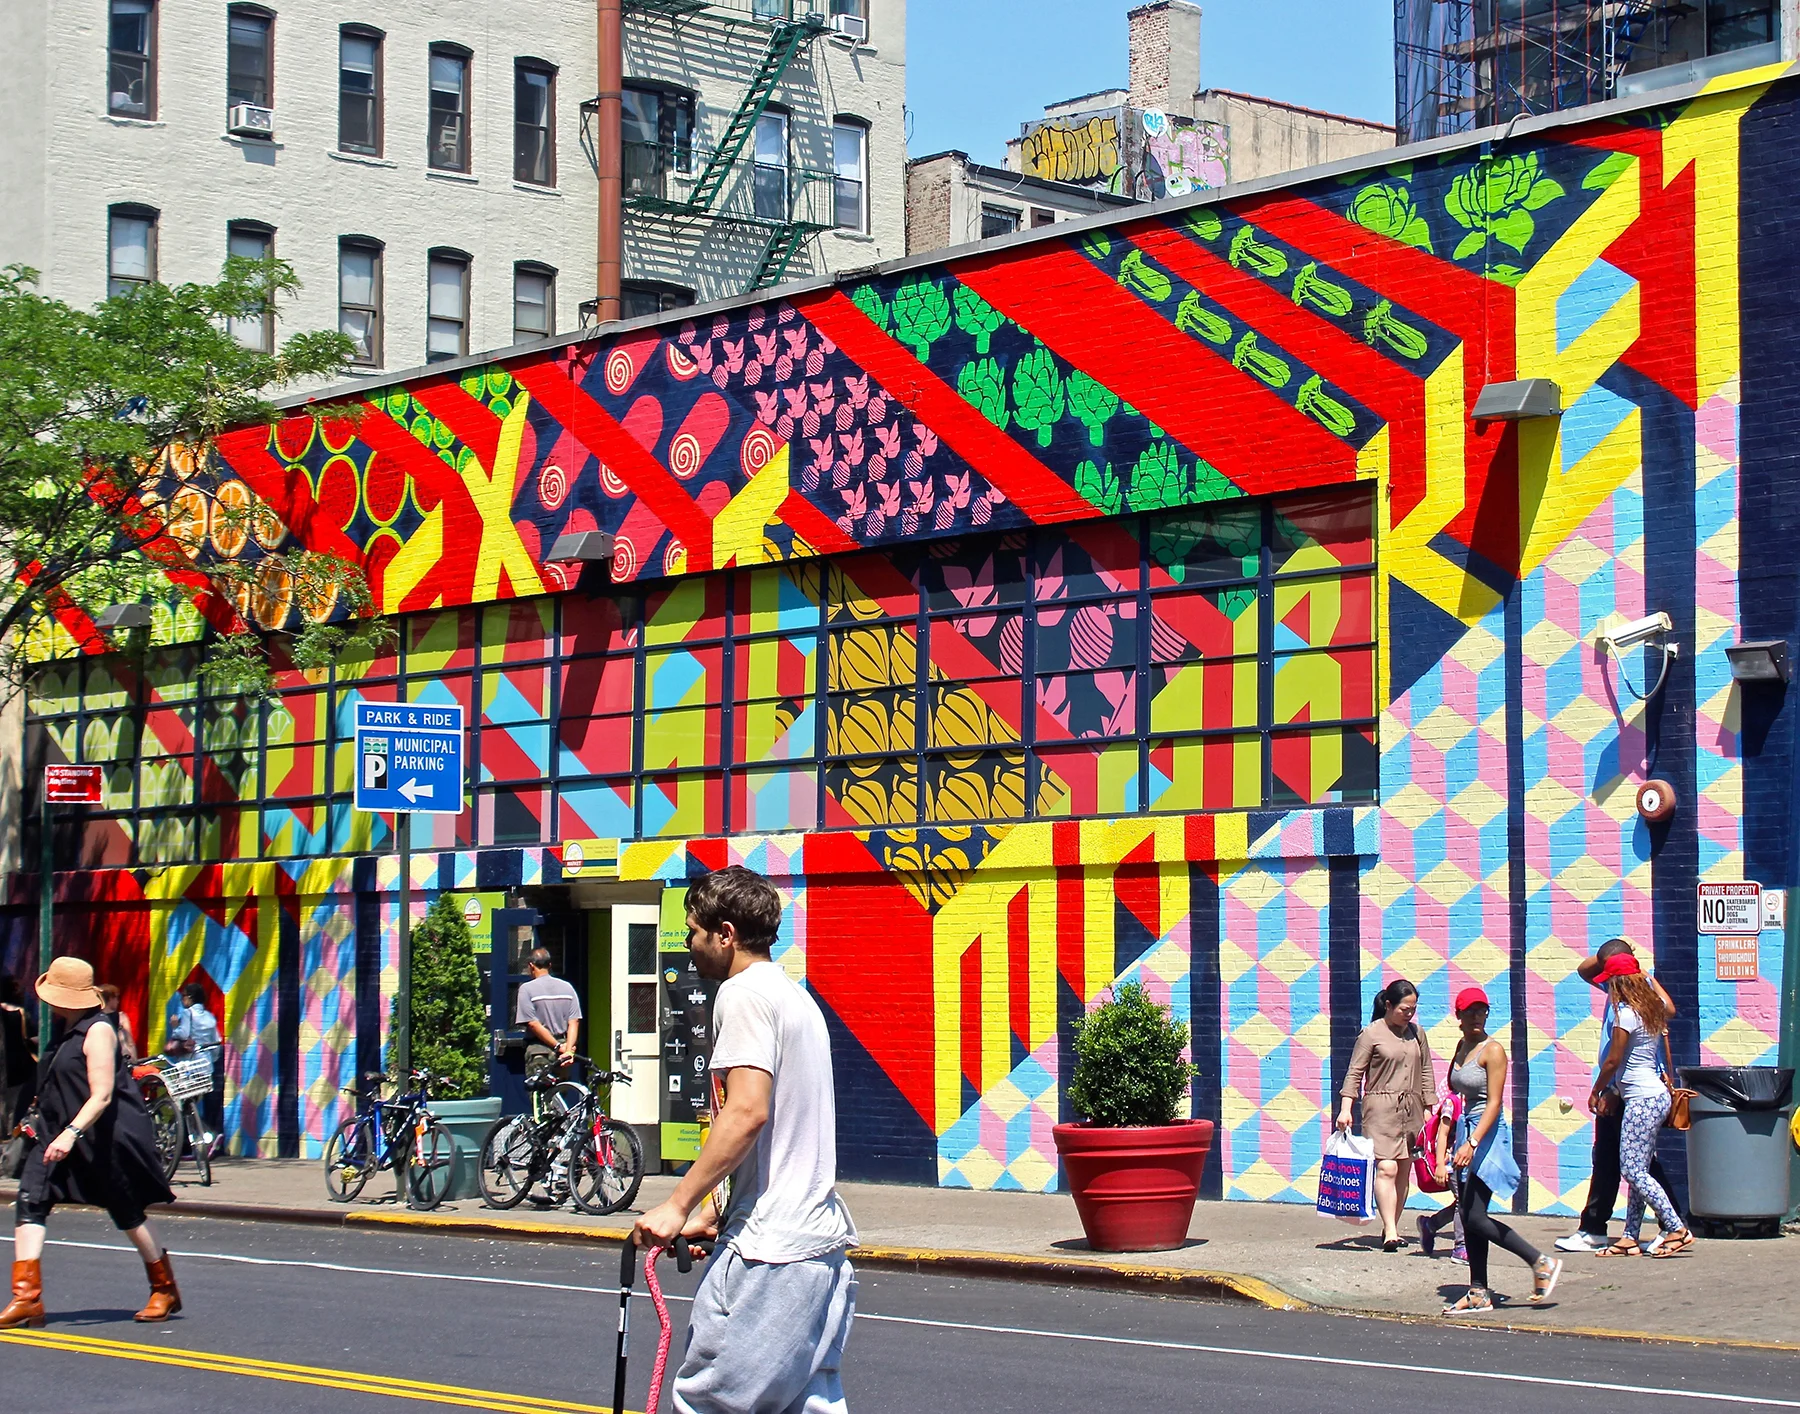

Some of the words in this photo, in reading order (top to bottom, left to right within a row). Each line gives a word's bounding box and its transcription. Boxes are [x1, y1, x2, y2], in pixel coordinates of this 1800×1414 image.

[366, 711, 402, 724] PARK
[408, 712, 418, 725] &
[423, 713, 453, 726] RIDE
[394, 737, 456, 754] MUNICIPAL
[394, 755, 445, 771] PARKING
[60, 769, 94, 777] STANDING
[364, 754, 387, 788] P
[48, 777, 77, 786] Anytime
[1701, 885, 1725, 895] PRIVATE
[1726, 885, 1756, 895] PROPERTY
[1703, 898, 1725, 924] NO
[1717, 939, 1756, 950] SPRINKLERS
[1717, 953, 1756, 963] THROUGHOUT
[1719, 965, 1755, 976] BUILDING
